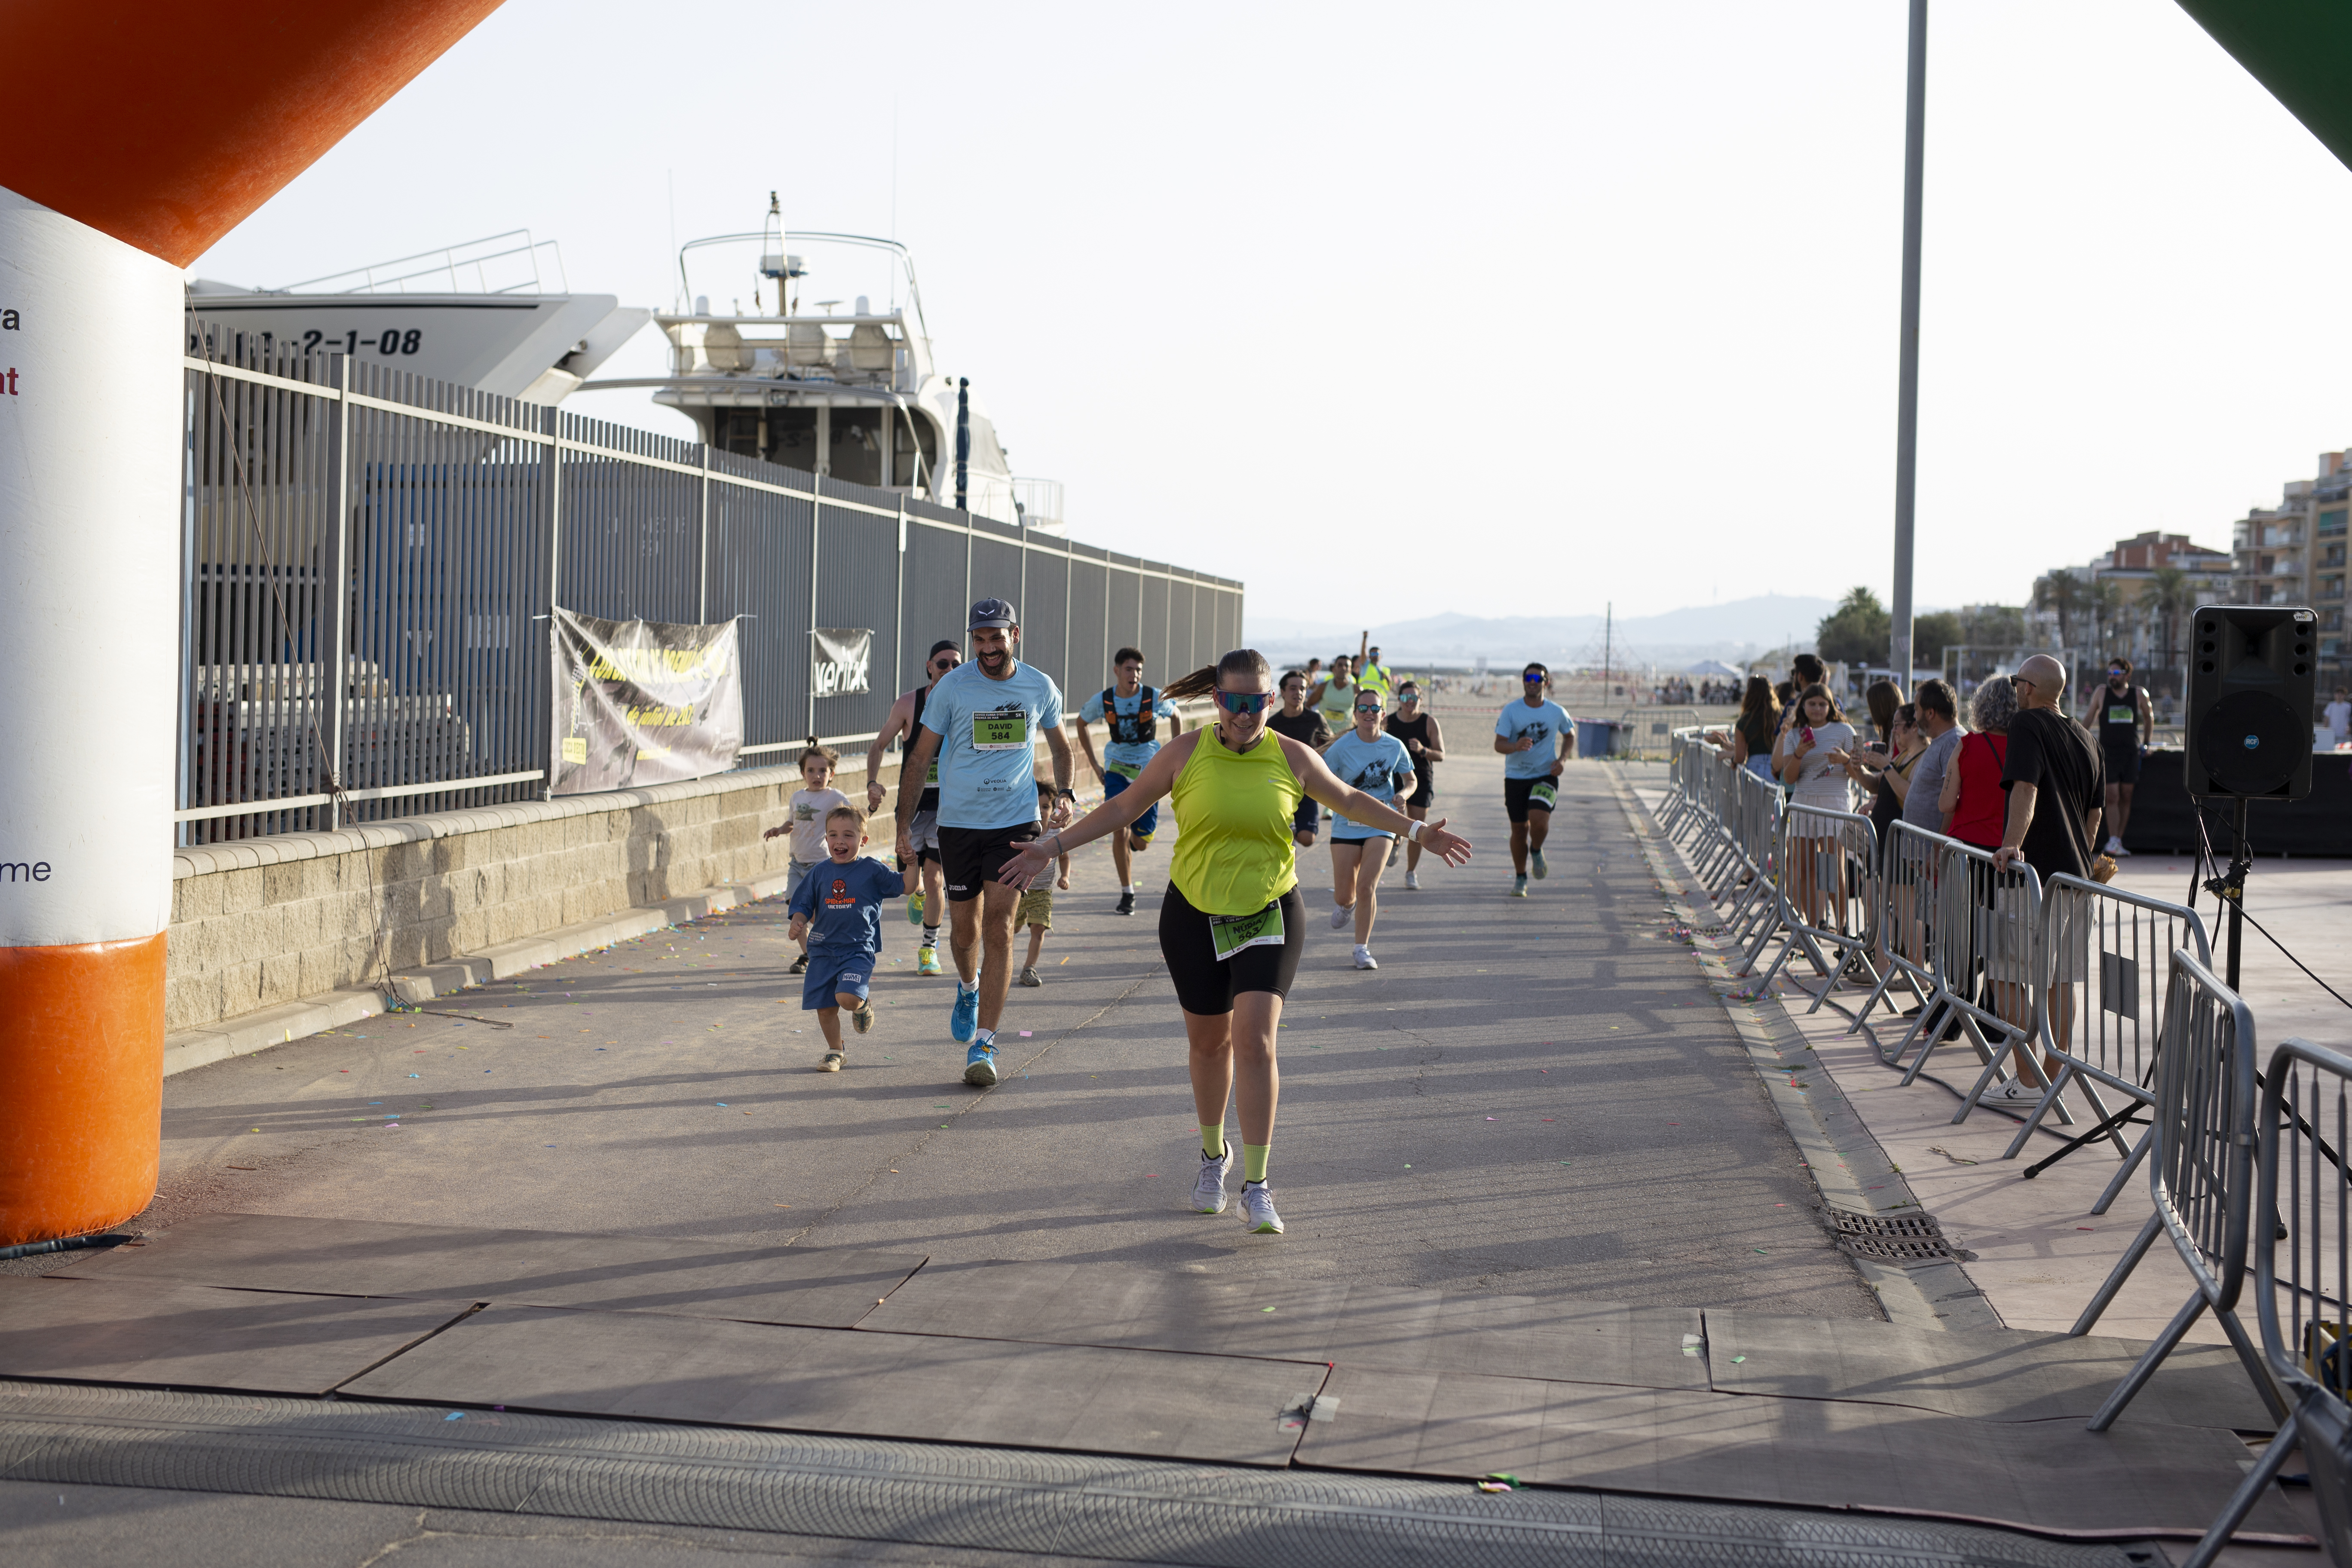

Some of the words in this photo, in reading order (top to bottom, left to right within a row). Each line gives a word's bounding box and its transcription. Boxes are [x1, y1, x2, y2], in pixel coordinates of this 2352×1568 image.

[0, 309, 20, 331] a
[0, 368, 18, 395] t
[627, 705, 640, 726] de
[636, 706, 668, 732] juliol
[664, 706, 677, 726] de
[991, 732, 1010, 740] 584
[1238, 927, 1260, 942] 563
[843, 974, 860, 982] MARVEL
